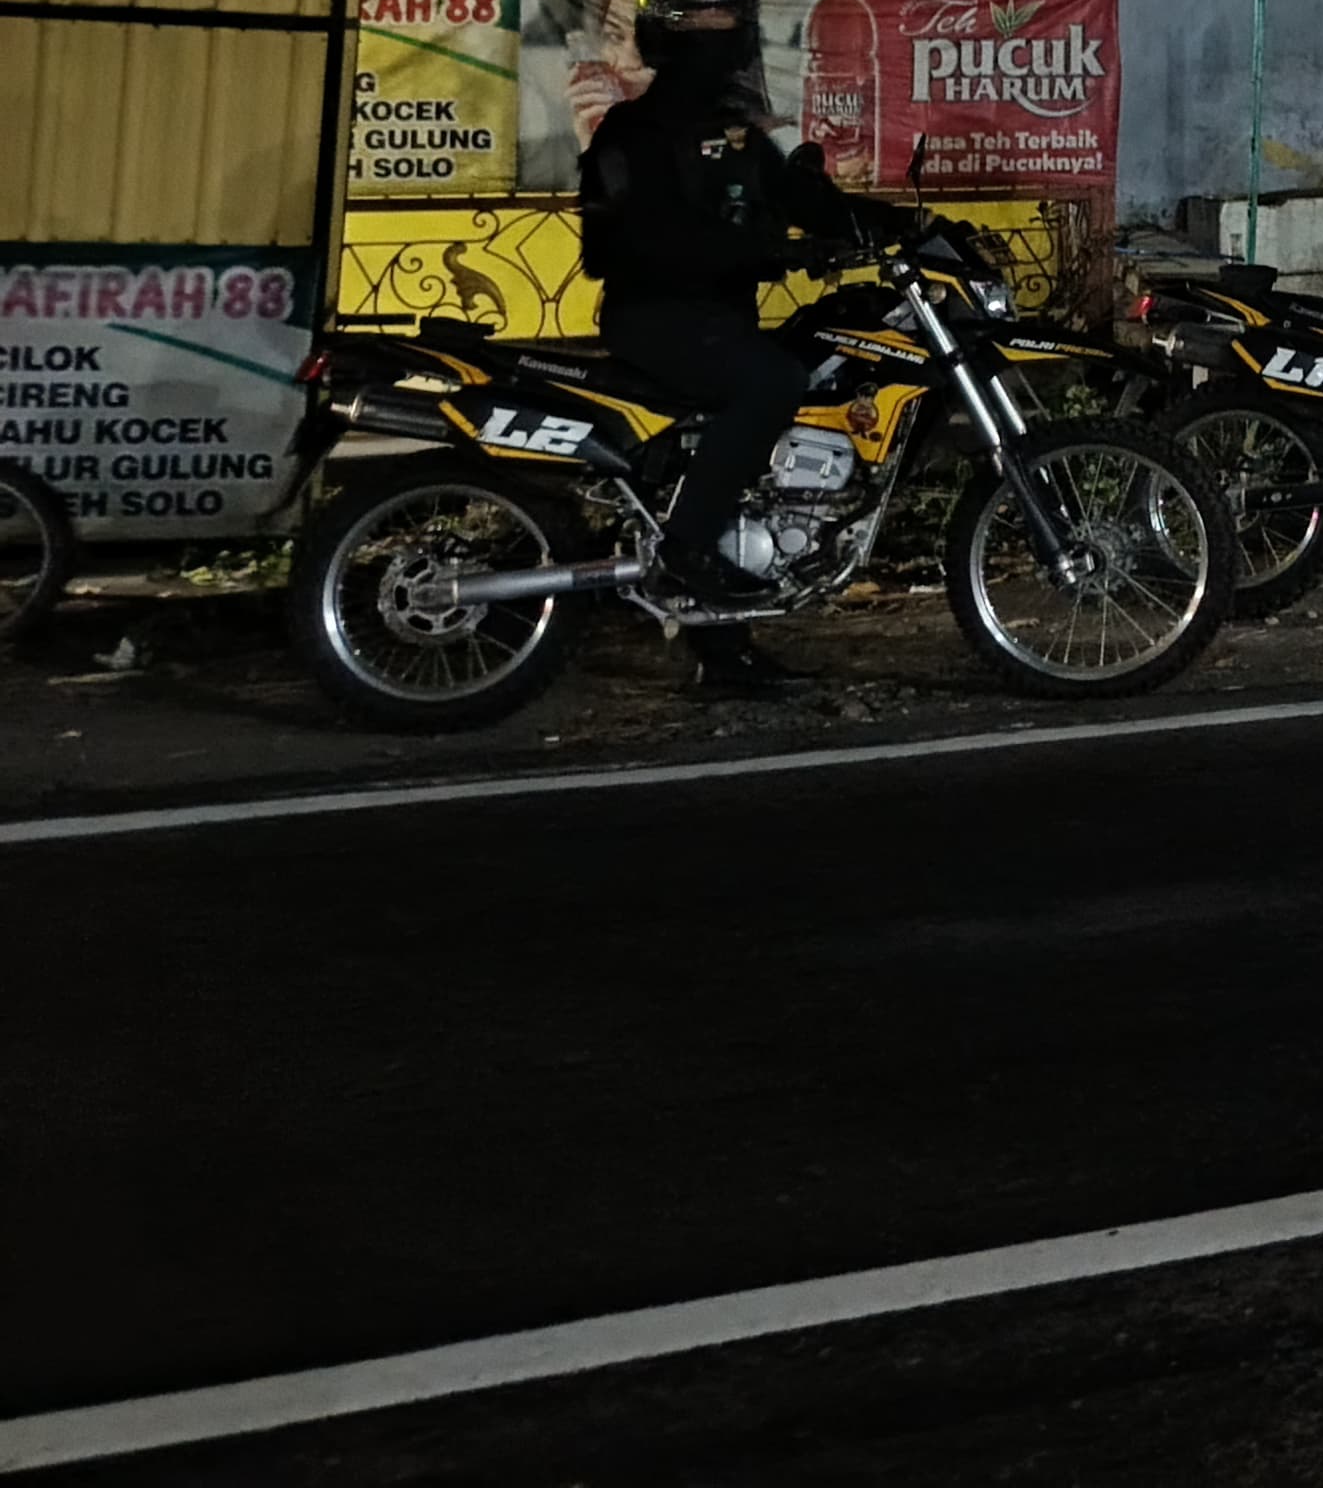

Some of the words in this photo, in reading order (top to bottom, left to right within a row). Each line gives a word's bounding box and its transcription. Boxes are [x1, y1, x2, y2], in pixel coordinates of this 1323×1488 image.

[944, 77, 1088, 104] HARUM
[352, 100, 455, 121] KOCEK
[364, 129, 492, 150] GULUNG
[970, 131, 1011, 151] Teh
[1014, 130, 1099, 150] Terbaik
[373, 157, 454, 178] SOLO
[919, 153, 953, 174] da
[957, 153, 981, 173] di
[985, 152, 1104, 175] Pucuknya!
[222, 272, 288, 320] 88
[0, 382, 130, 409] IRENG
[94, 417, 229, 445] KOCEK
[475, 406, 595, 456] L2
[111, 453, 273, 481] GULUNG
[121, 490, 223, 517] SOLO
